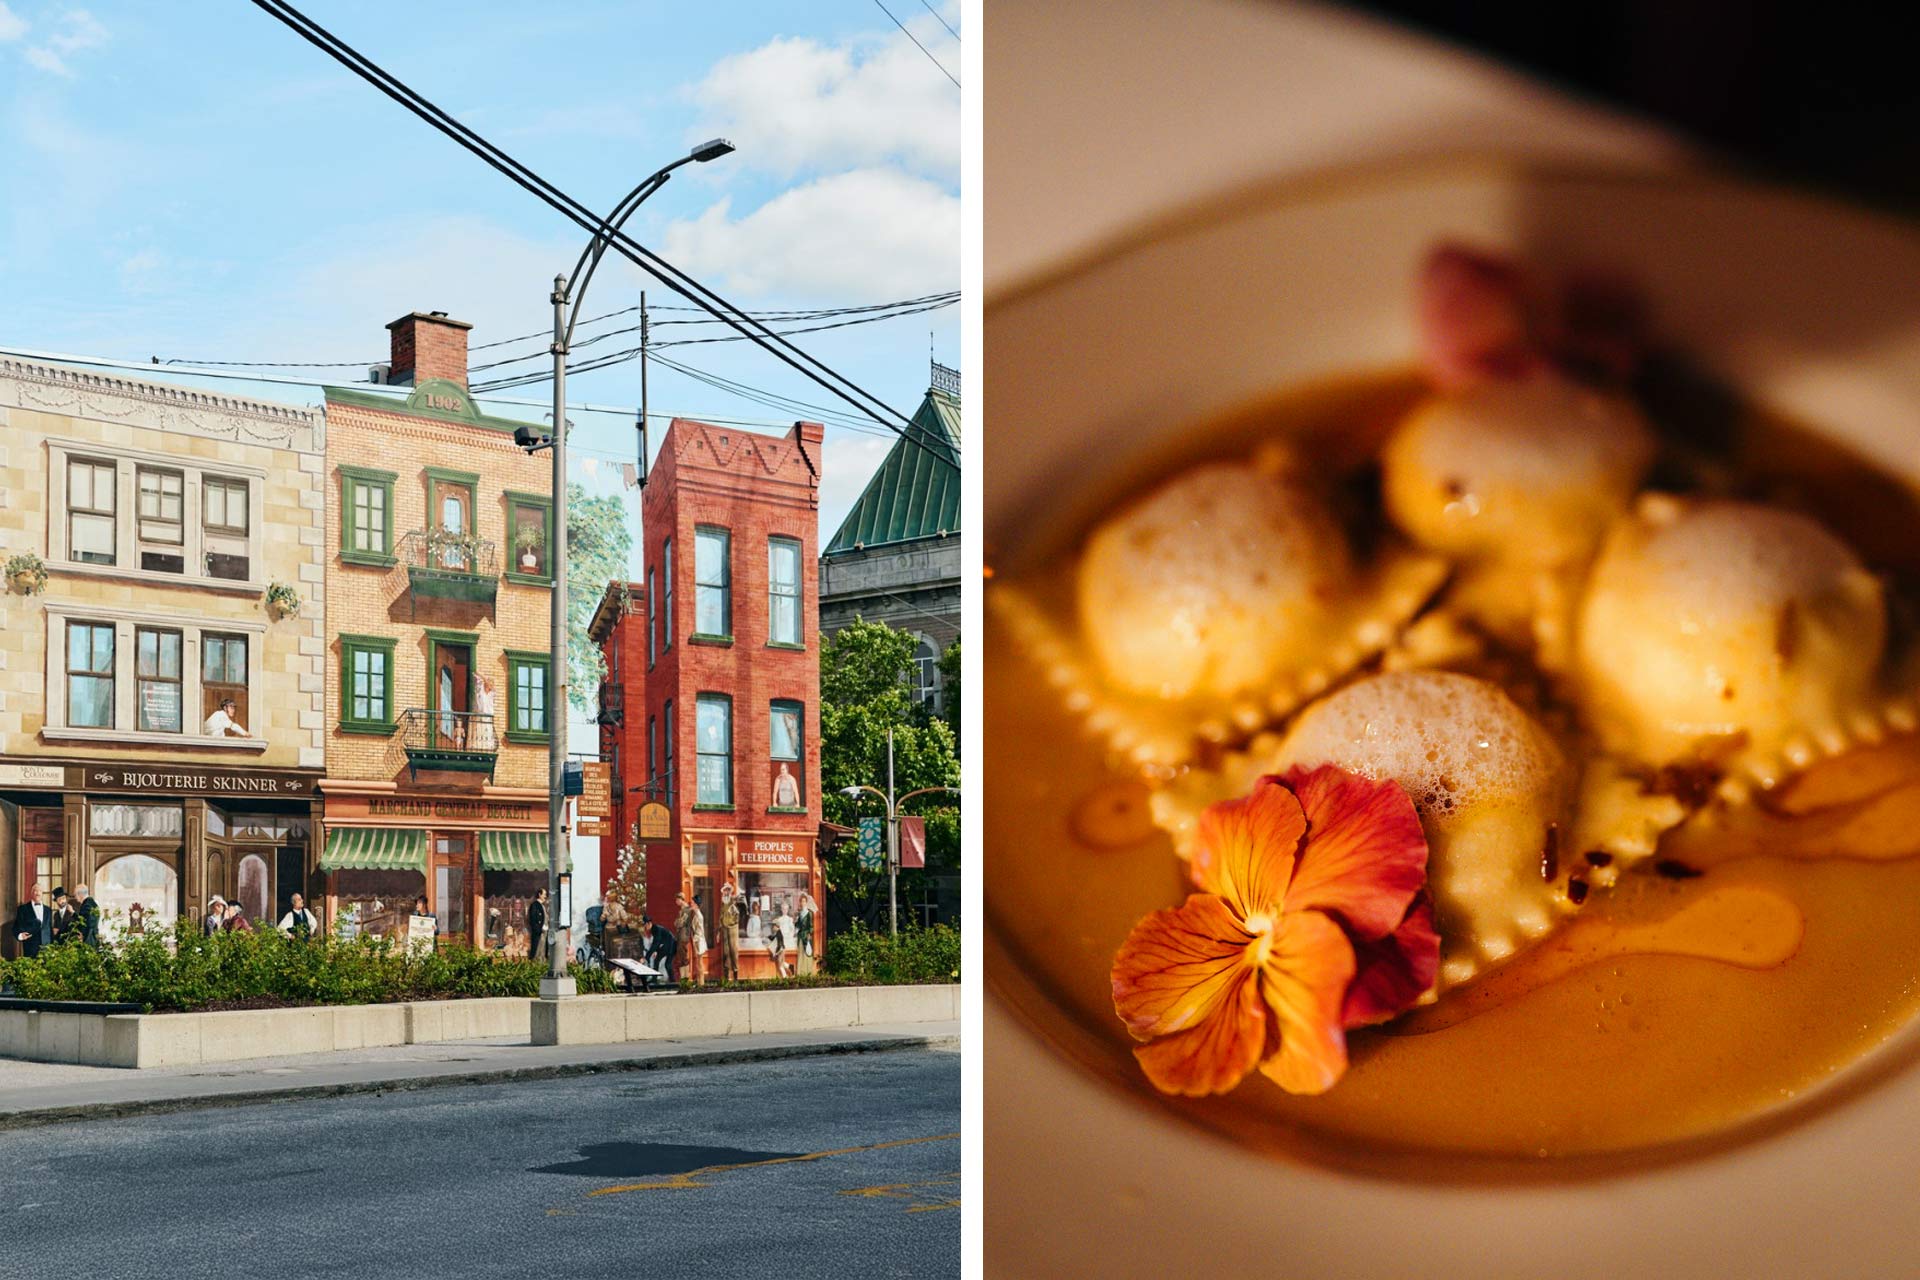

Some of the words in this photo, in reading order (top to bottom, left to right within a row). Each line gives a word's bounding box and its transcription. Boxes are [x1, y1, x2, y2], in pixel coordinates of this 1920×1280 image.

[426, 393, 462, 412] 1902
[123, 772, 207, 789] BIJOUTERIE
[213, 776, 278, 792] SKINNER
[368, 799, 431, 817] MARCHAND
[434, 801, 483, 818] GENERAL
[754, 841, 794, 852] PEOPLE'S
[740, 852, 793, 863] TELEPHONE
